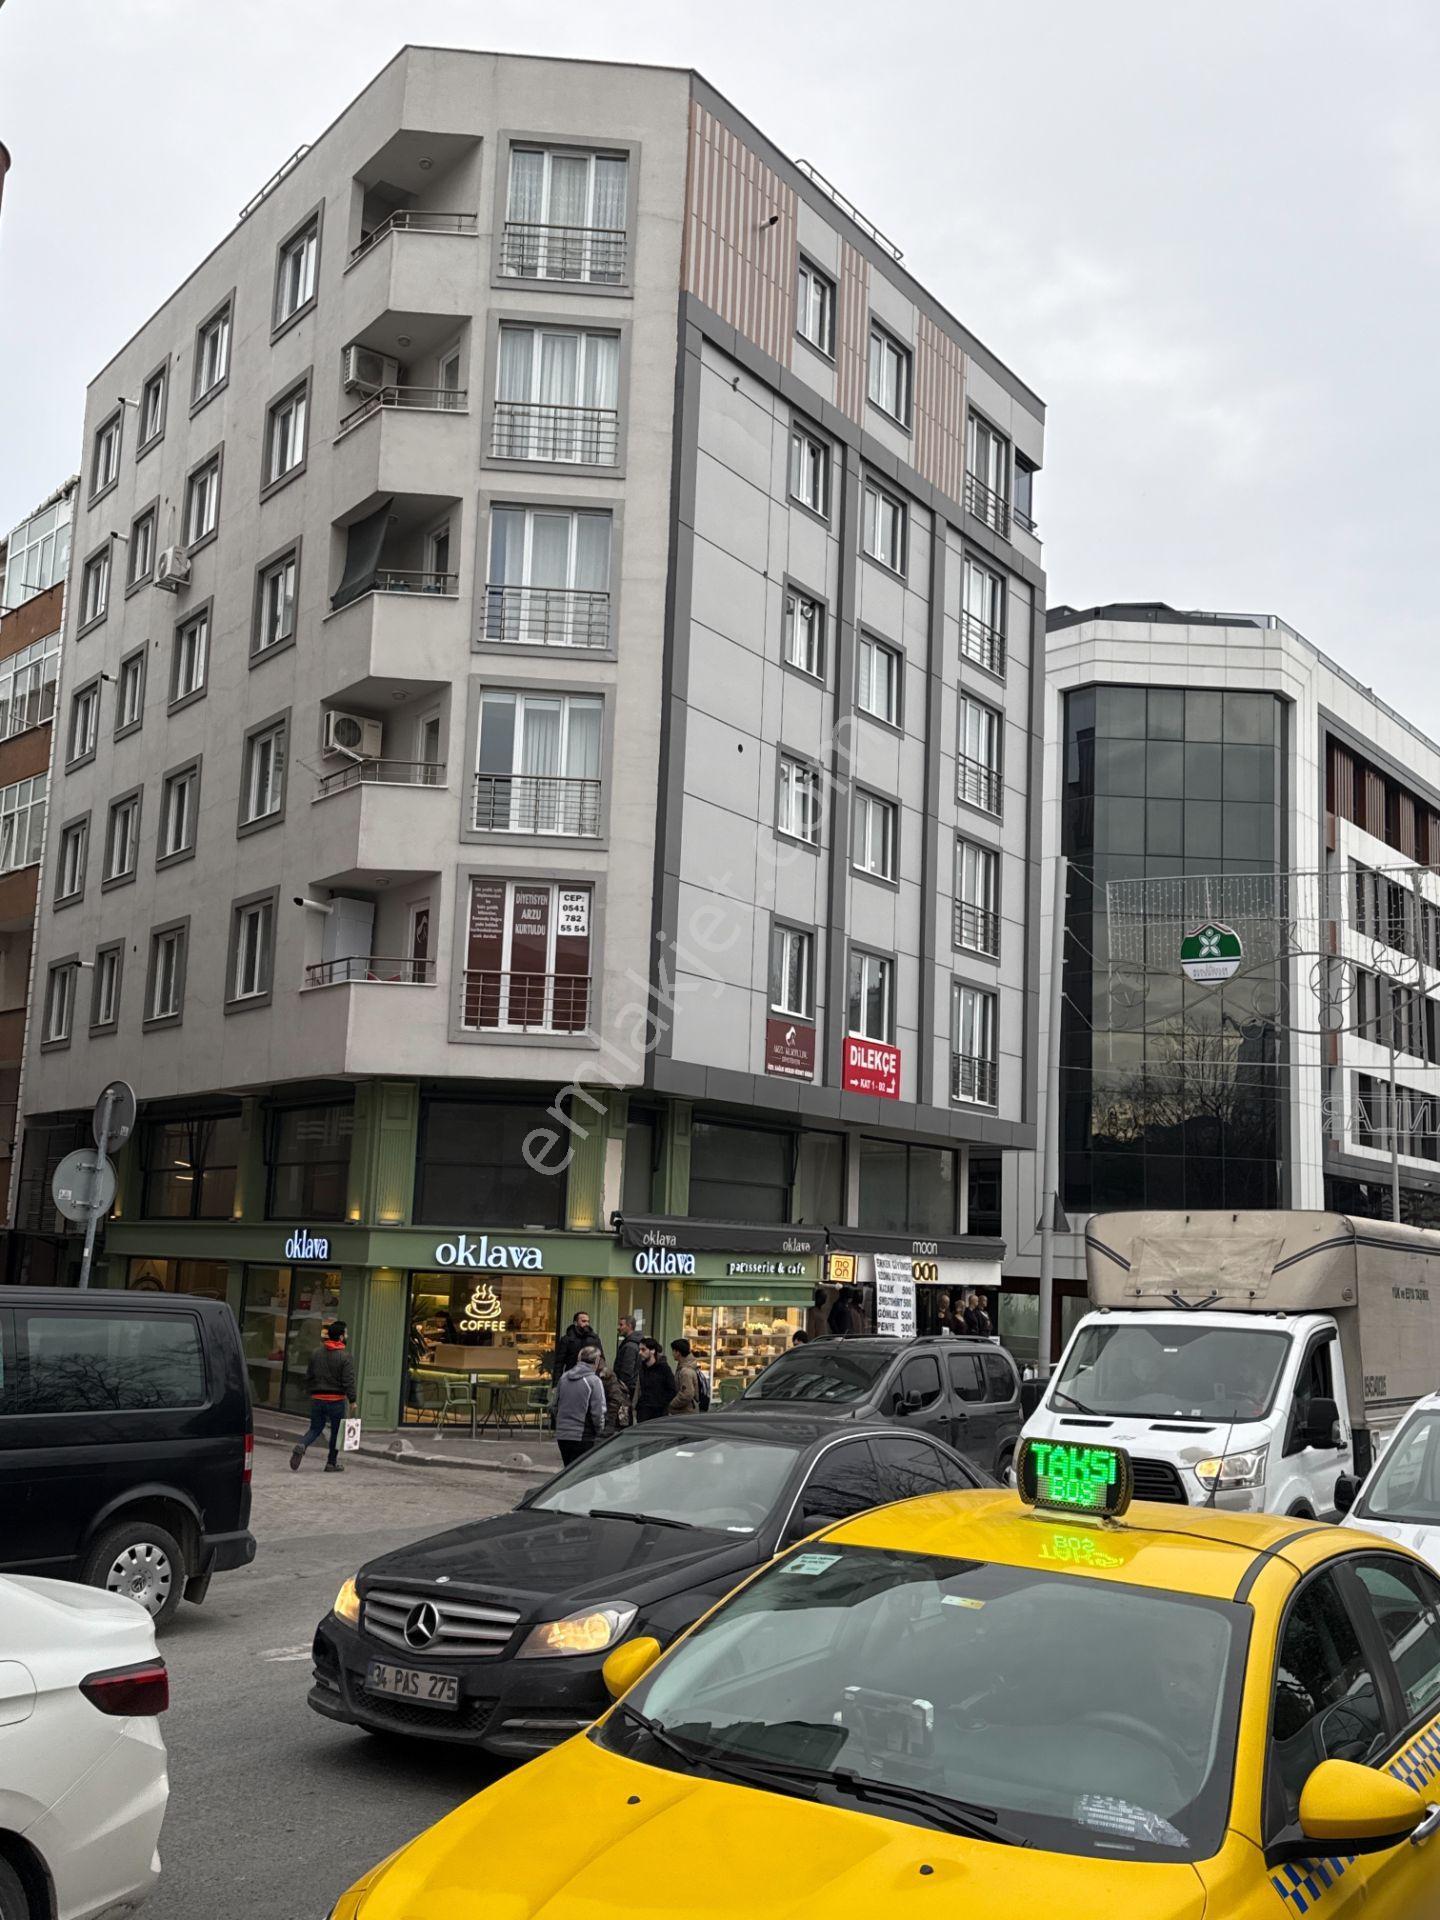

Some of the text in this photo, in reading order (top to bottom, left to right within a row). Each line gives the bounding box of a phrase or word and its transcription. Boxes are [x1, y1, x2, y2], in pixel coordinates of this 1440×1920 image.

[564, 894, 585, 902] CEP:
[521, 909, 542, 920] ARZU
[565, 914, 582, 922] 782
[515, 923, 546, 936] KURTULDU
[560, 925, 586, 933] 55 54
[850, 1045, 897, 1077] DİLEKÇE
[860, 1078, 871, 1089] KAT
[285, 1229, 329, 1259] oklava
[643, 1230, 677, 1247] oklava
[783, 1238, 811, 1251] oklava
[435, 1235, 544, 1269] oklava
[912, 1241, 938, 1255] moon
[635, 1248, 696, 1274] oklava
[730, 1261, 806, 1275] patisserie & cafe
[877, 1308, 899, 1319] GÖMLEK
[459, 1320, 506, 1332] COFFEE
[375, 1665, 457, 1701] 34 PAS 275
